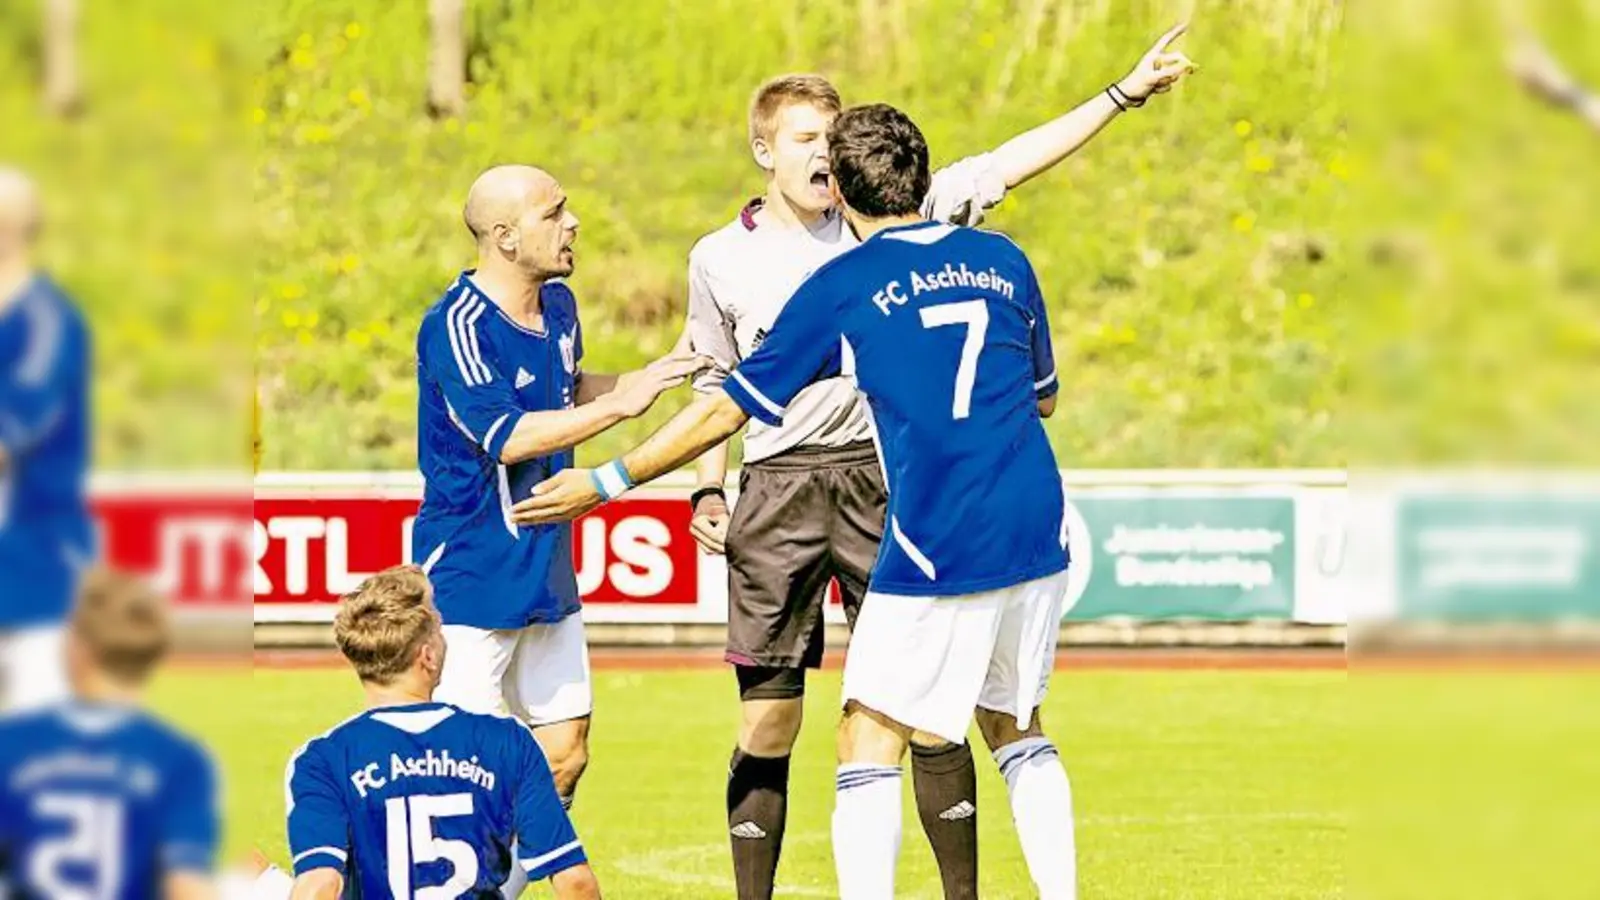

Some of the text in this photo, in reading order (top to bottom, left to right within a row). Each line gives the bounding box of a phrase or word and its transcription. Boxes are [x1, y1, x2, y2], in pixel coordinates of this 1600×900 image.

[872, 263, 1014, 316] FC Aschheim
[919, 299, 989, 420] 7
[351, 749, 496, 798] FC Aschheim
[385, 792, 479, 900] 15
